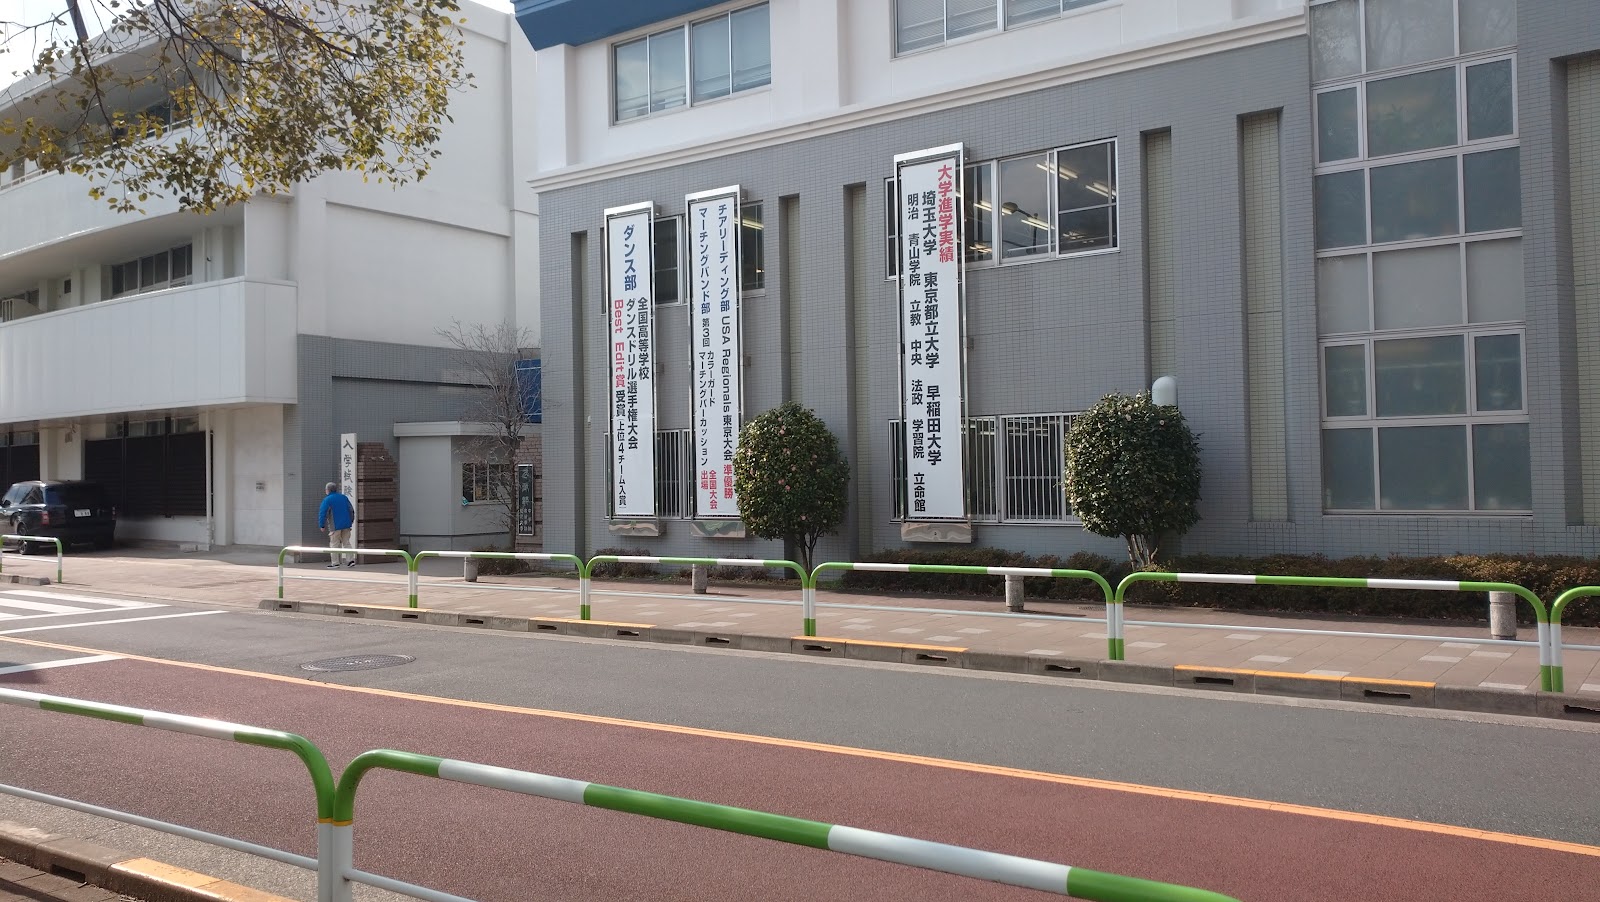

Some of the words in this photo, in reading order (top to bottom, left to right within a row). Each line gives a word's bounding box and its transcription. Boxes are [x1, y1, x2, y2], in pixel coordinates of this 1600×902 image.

[908, 193, 919, 220] 明治
[922, 190, 937, 255] 埼玉大学
[938, 165, 954, 263] 大学進学実績
[624, 224, 636, 291] ダンス部
[699, 208, 710, 314] マーチングバンド部
[719, 204, 730, 312] チアリーディング部
[909, 233, 920, 286] 青山学院
[615, 299, 623, 333] Best
[702, 318, 710, 347] 第3回
[722, 316, 730, 345] USA
[910, 300, 921, 326] 立教
[924, 272, 939, 368] 東京都立大学
[638, 297, 649, 380] 全国高等学校
[911, 340, 922, 365] 中央
[626, 298, 638, 449] ダンスドリル選手権大会
[722, 349, 731, 412] Regionals
[912, 379, 923, 405] 法政
[723, 415, 733, 461] 東京大会
[912, 419, 924, 459] 学習院
[927, 385, 941, 465] 早稲田大学
[701, 470, 708, 489] 出場
[709, 470, 717, 509] 全国大会
[724, 463, 734, 499] 準優勝
[914, 472, 925, 512] 立命館
